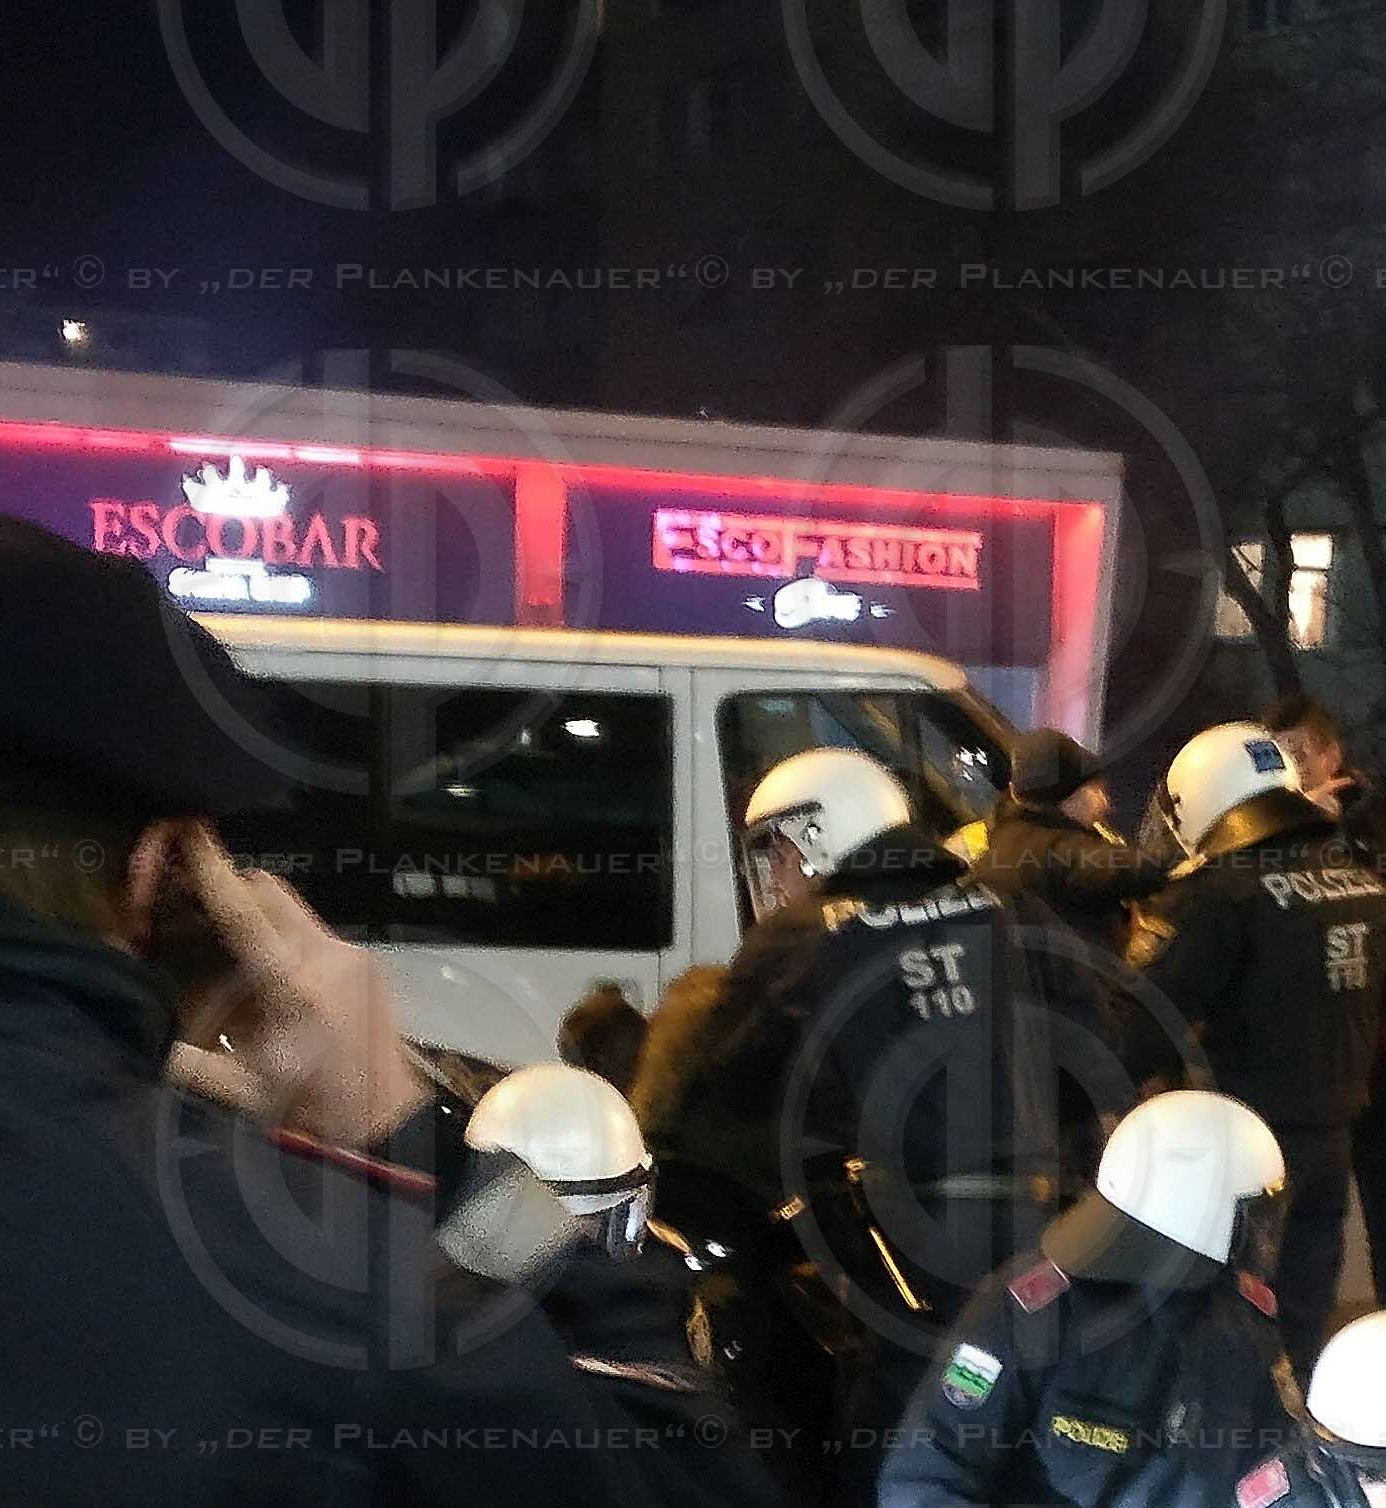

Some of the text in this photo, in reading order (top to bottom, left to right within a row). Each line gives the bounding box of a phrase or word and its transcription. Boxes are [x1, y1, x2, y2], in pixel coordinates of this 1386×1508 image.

[89, 497, 386, 574] ESCOBAR
[1326, 922, 1371, 959] ST
[898, 944, 965, 989] ST
[909, 984, 977, 1020] 110
